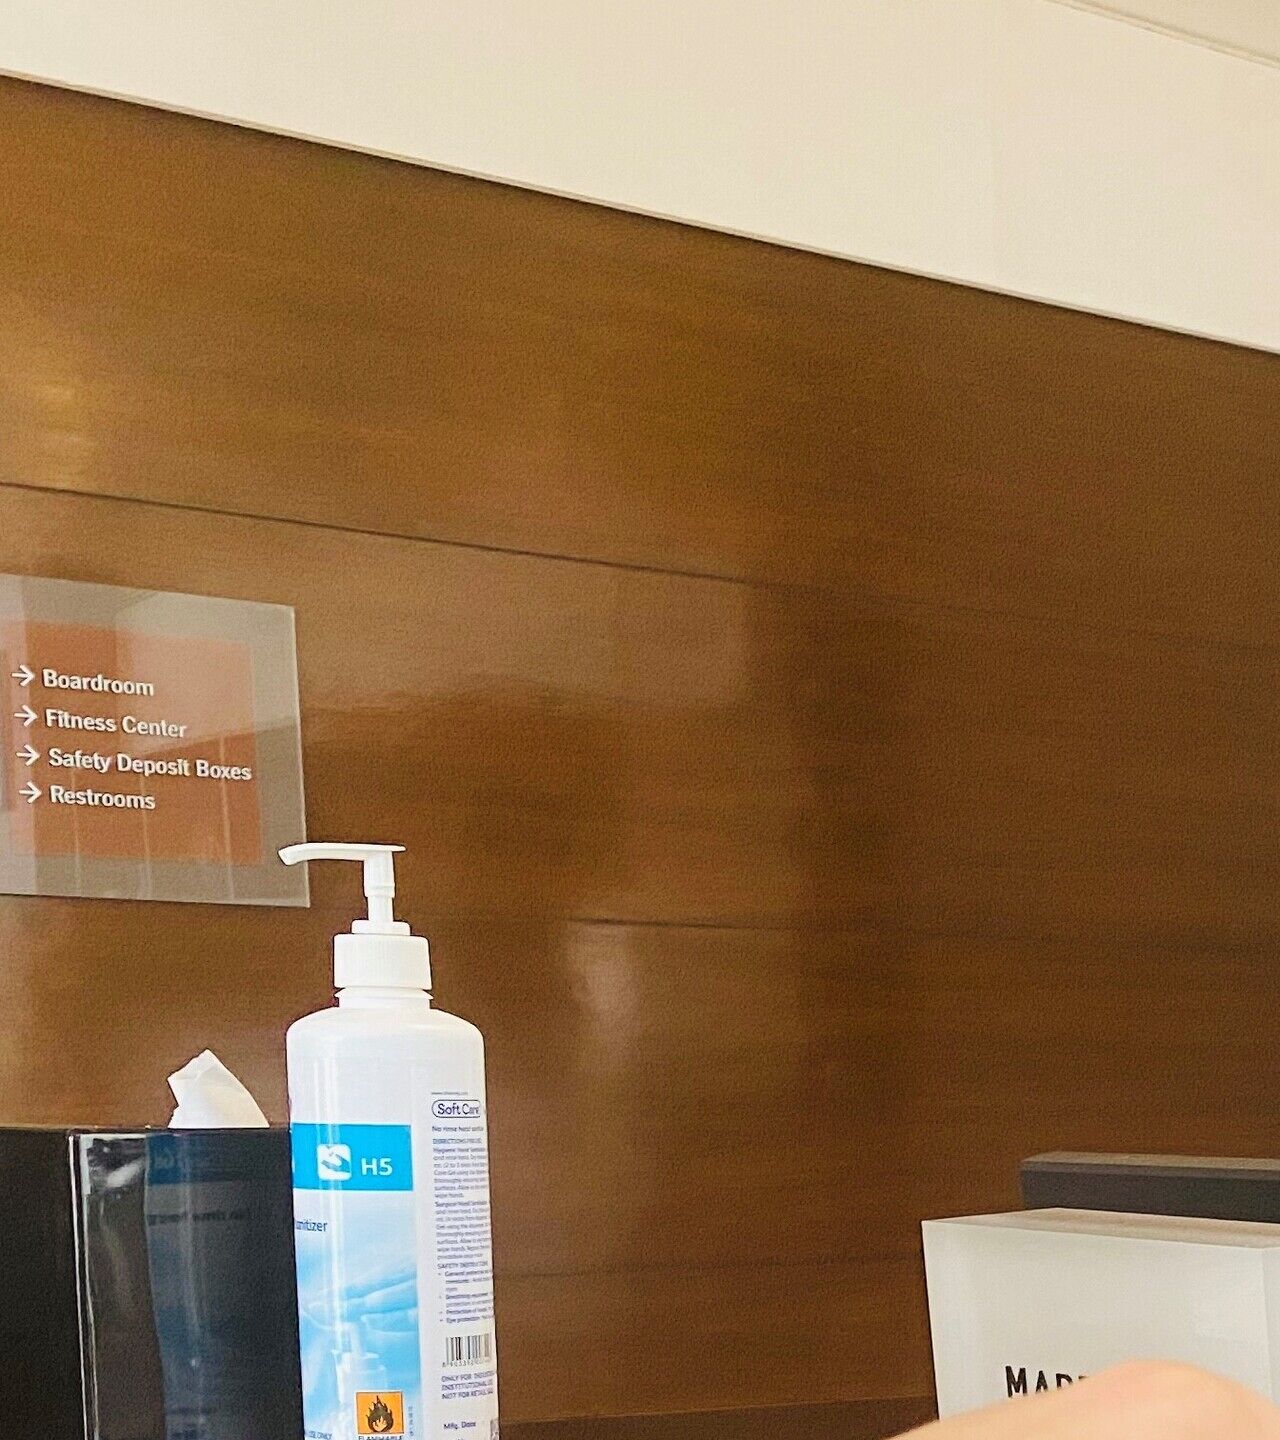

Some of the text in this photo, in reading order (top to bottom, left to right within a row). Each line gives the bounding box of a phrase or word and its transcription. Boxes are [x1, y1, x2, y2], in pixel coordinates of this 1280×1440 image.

[42, 668, 155, 697] Boardroom
[45, 708, 187, 739] Fitness Center
[49, 748, 253, 781] Safety Deposit Boxes
[50, 785, 156, 811] Restrooms
[361, 1157, 393, 1176] H5
